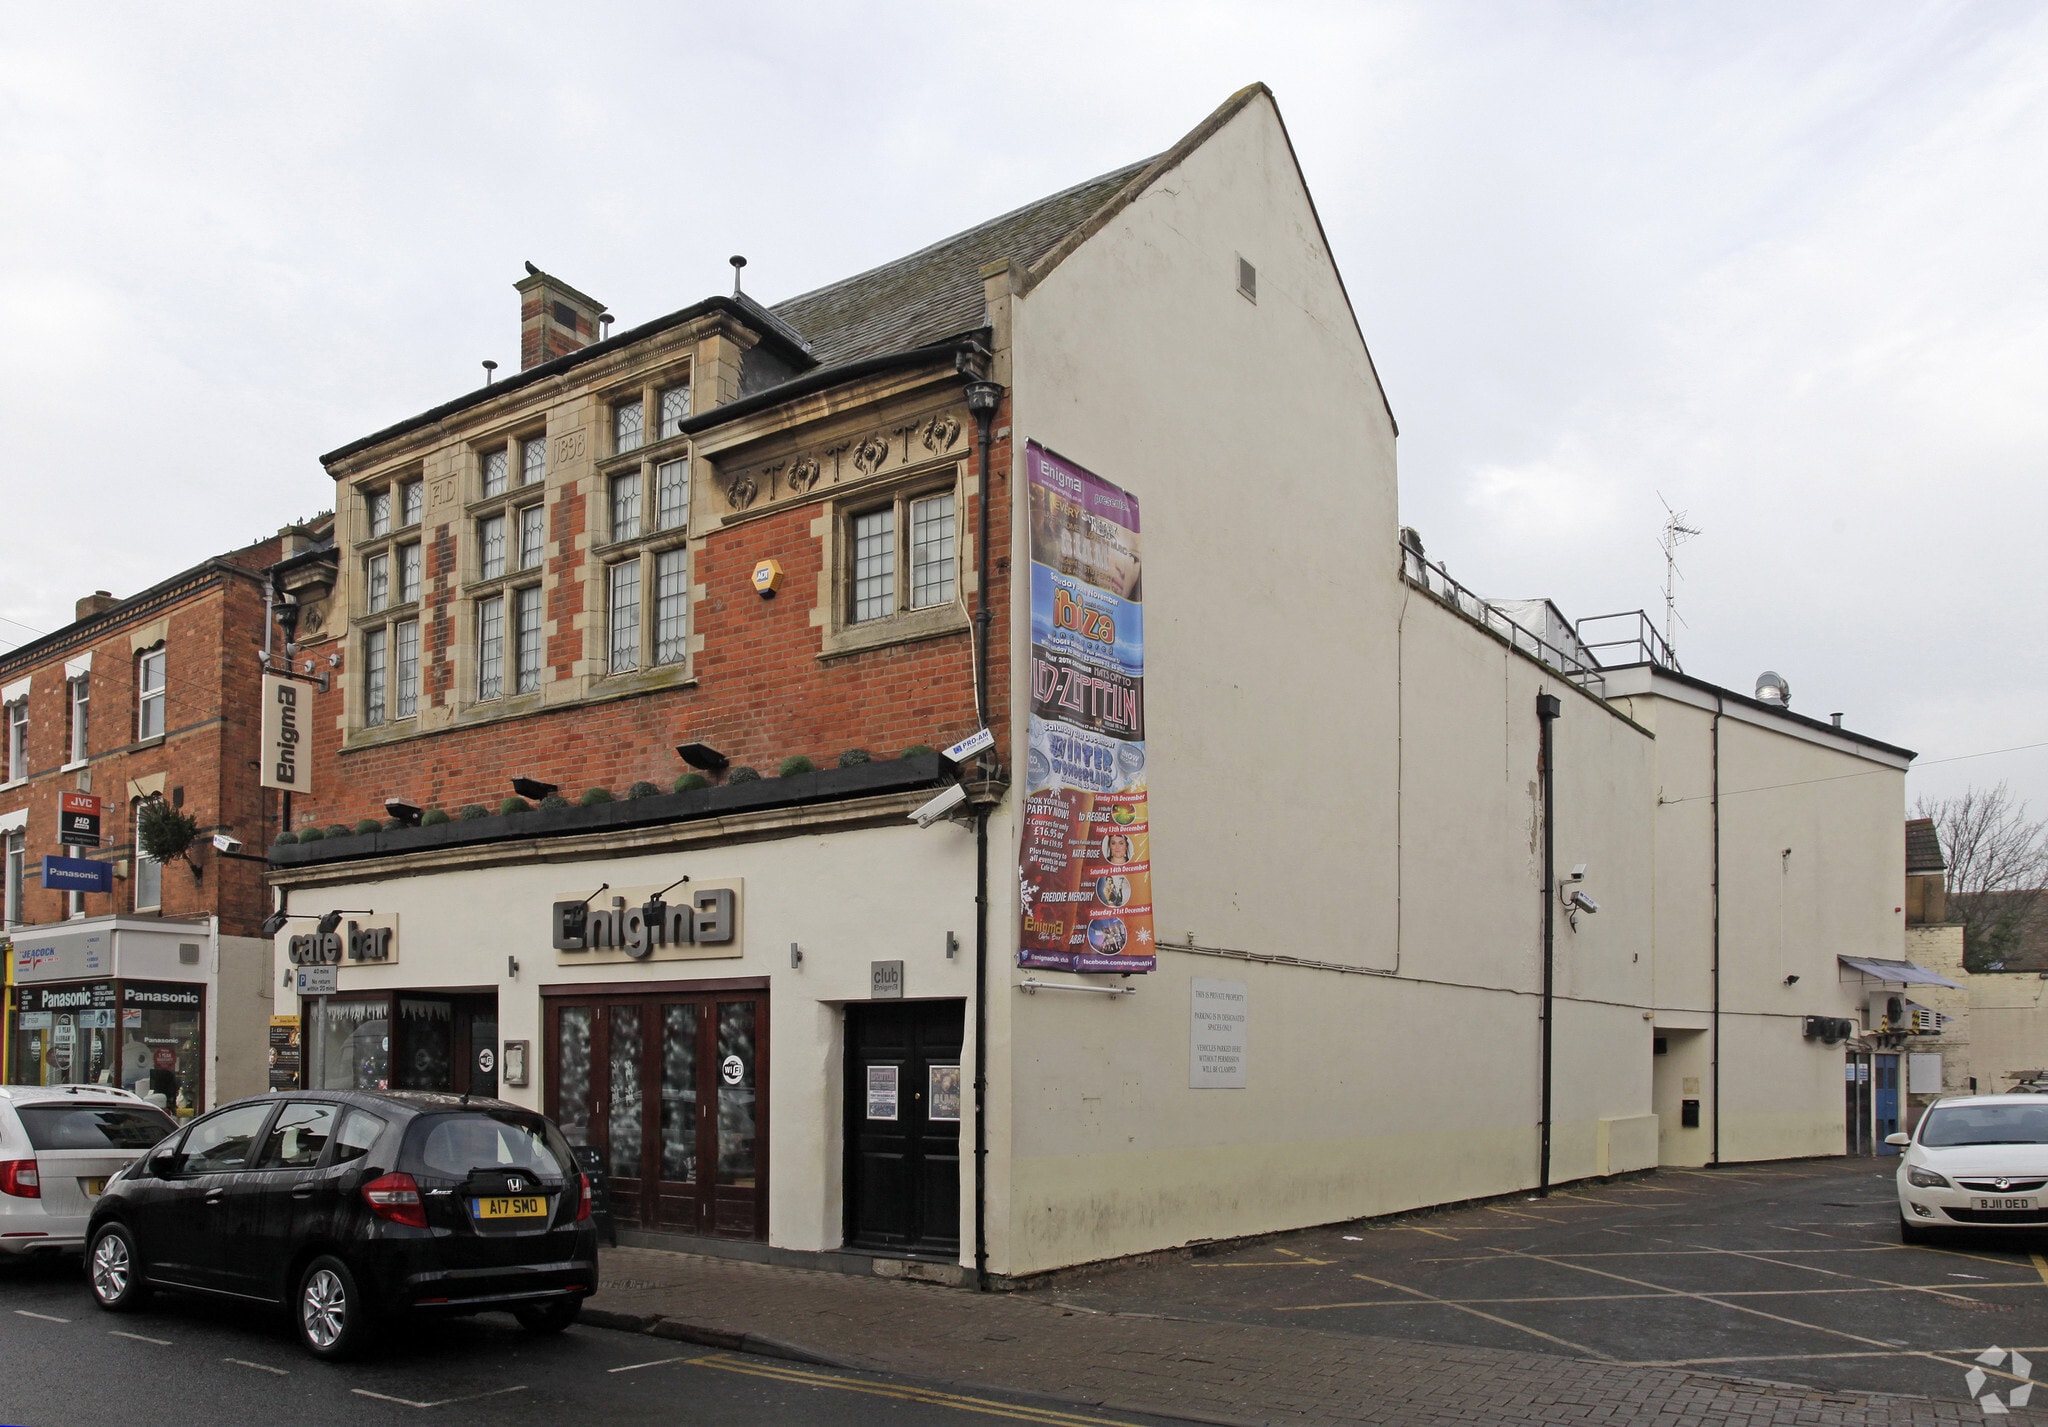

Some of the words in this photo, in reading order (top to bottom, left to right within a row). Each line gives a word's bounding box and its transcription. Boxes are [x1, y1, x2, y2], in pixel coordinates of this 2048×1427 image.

[1040, 460, 1082, 493] Enigma
[1055, 501, 1081, 520] EVERY
[756, 569, 770, 582] ADT
[1053, 587, 1116, 644] ibiza
[276, 684, 299, 784] Enigma
[1048, 732, 1113, 773] WINTER
[71, 797, 93, 808] JVC
[1027, 797, 1043, 805] BOOK
[1119, 794, 1145, 802] December
[1026, 804, 1053, 815] PARTY
[1053, 808, 1070, 820] NOW!
[1078, 811, 1085, 822] to
[1086, 811, 1110, 823] REGGAE
[75, 816, 90, 825] HD
[1031, 818, 1053, 828] Courses
[1033, 827, 1057, 838] £16.95
[1108, 825, 1119, 833] 13th
[1120, 824, 1146, 832] December
[1041, 838, 1049, 846] for
[1029, 847, 1041, 855] Plus
[1029, 854, 1038, 862] all
[49, 868, 99, 880] Panasonic
[1090, 866, 1109, 876] Saturday
[1109, 866, 1121, 874] 14th
[1121, 864, 1148, 873] December
[1040, 891, 1067, 903] FREDDIE
[1067, 891, 1095, 902] MERCURY
[1089, 909, 1112, 917] Saturday
[1112, 908, 1124, 916] 21st
[1124, 906, 1151, 915] December
[553, 889, 735, 959] Enigma
[1024, 916, 1064, 936] Enigma
[347, 920, 393, 962] bar
[1069, 934, 1085, 945] ABBA
[22, 947, 56, 959] JEACOCK
[300, 975, 306, 985] P
[874, 968, 899, 984] club
[874, 984, 898, 992] Enigma
[41, 986, 91, 1009] Panasonic
[124, 988, 199, 1004] Panasonic
[144, 1036, 179, 1044] Panasonic
[514, 1199, 538, 1214] SMO
[2006, 1199, 2029, 1209] OED
